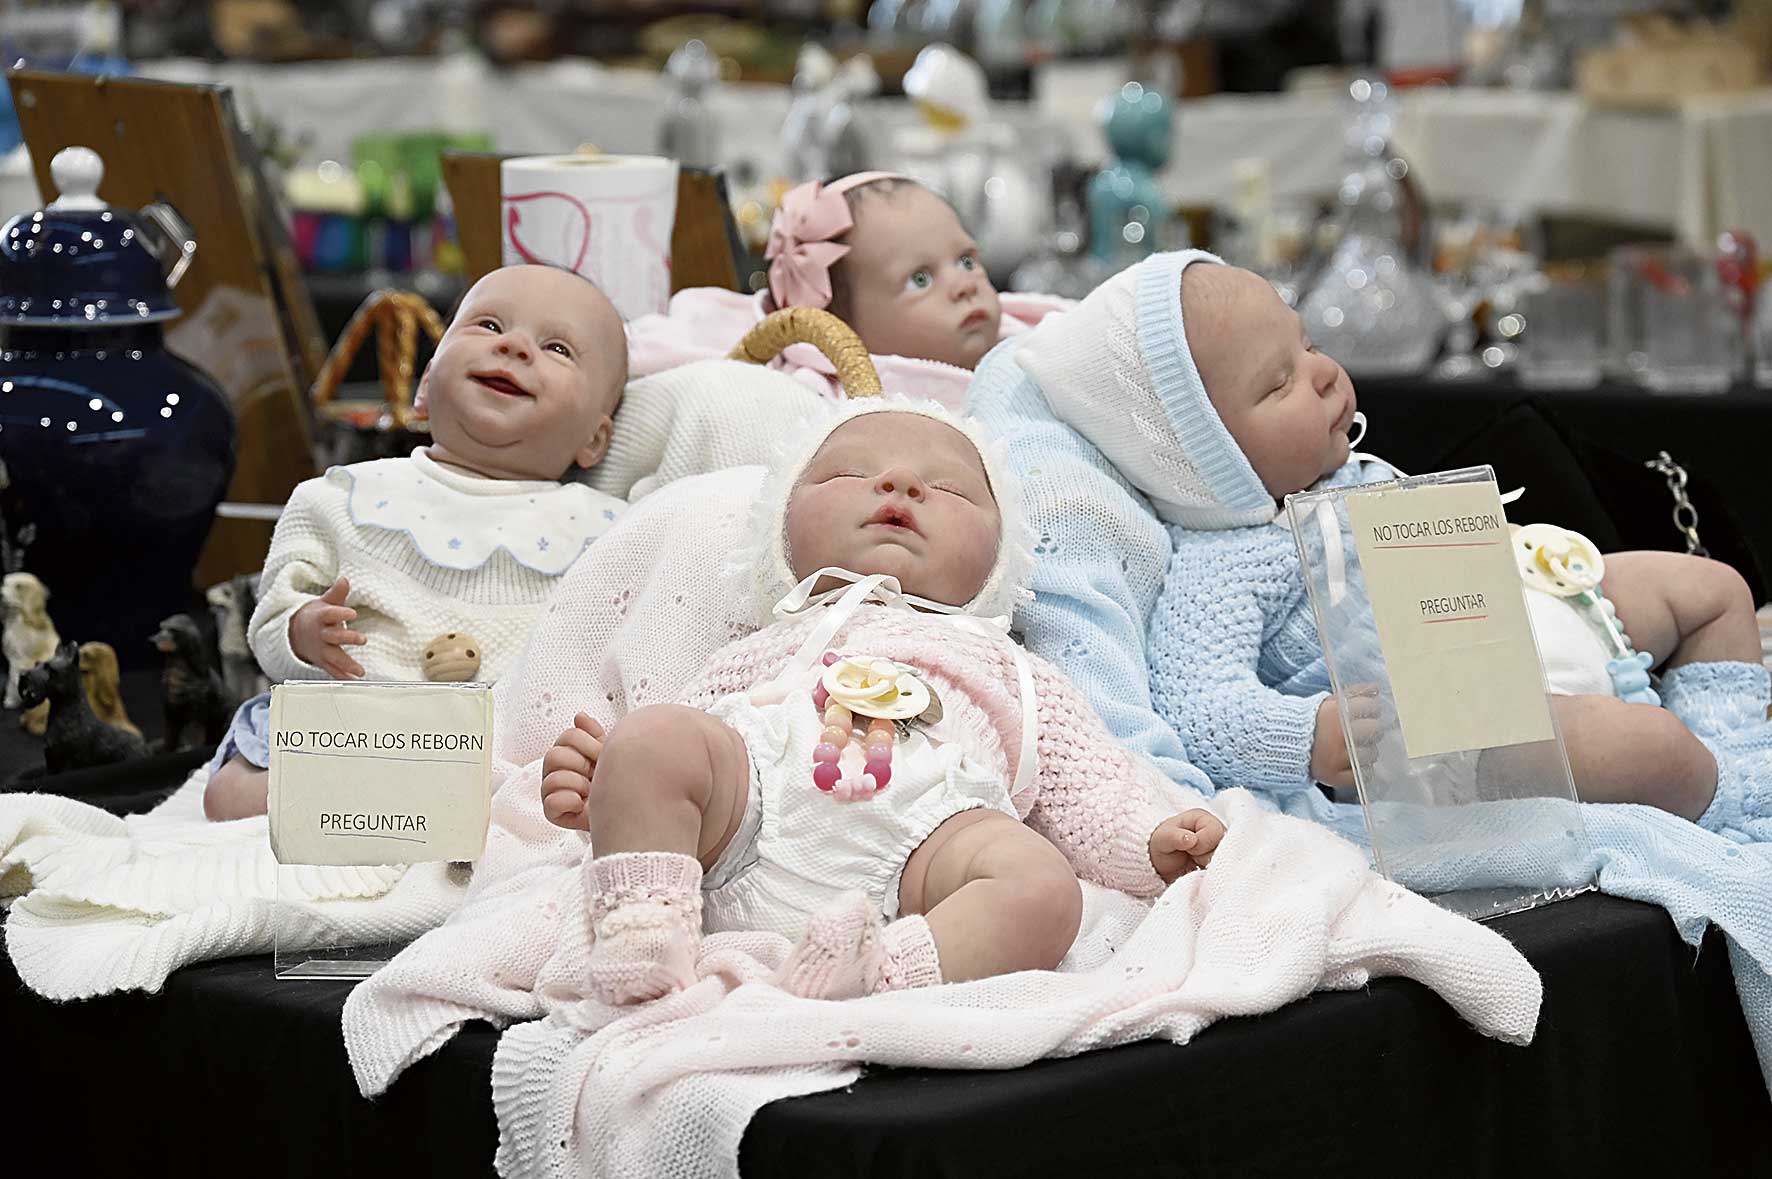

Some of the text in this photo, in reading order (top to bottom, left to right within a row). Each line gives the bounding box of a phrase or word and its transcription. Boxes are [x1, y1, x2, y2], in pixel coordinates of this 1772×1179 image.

[1373, 514, 1500, 542] NO TOCAR LOS REBORN
[1420, 593, 1487, 615] PREGUNTAR
[276, 731, 483, 751] NO TOCAR LOS REBORN
[320, 813, 427, 831] PREGUNTAR
